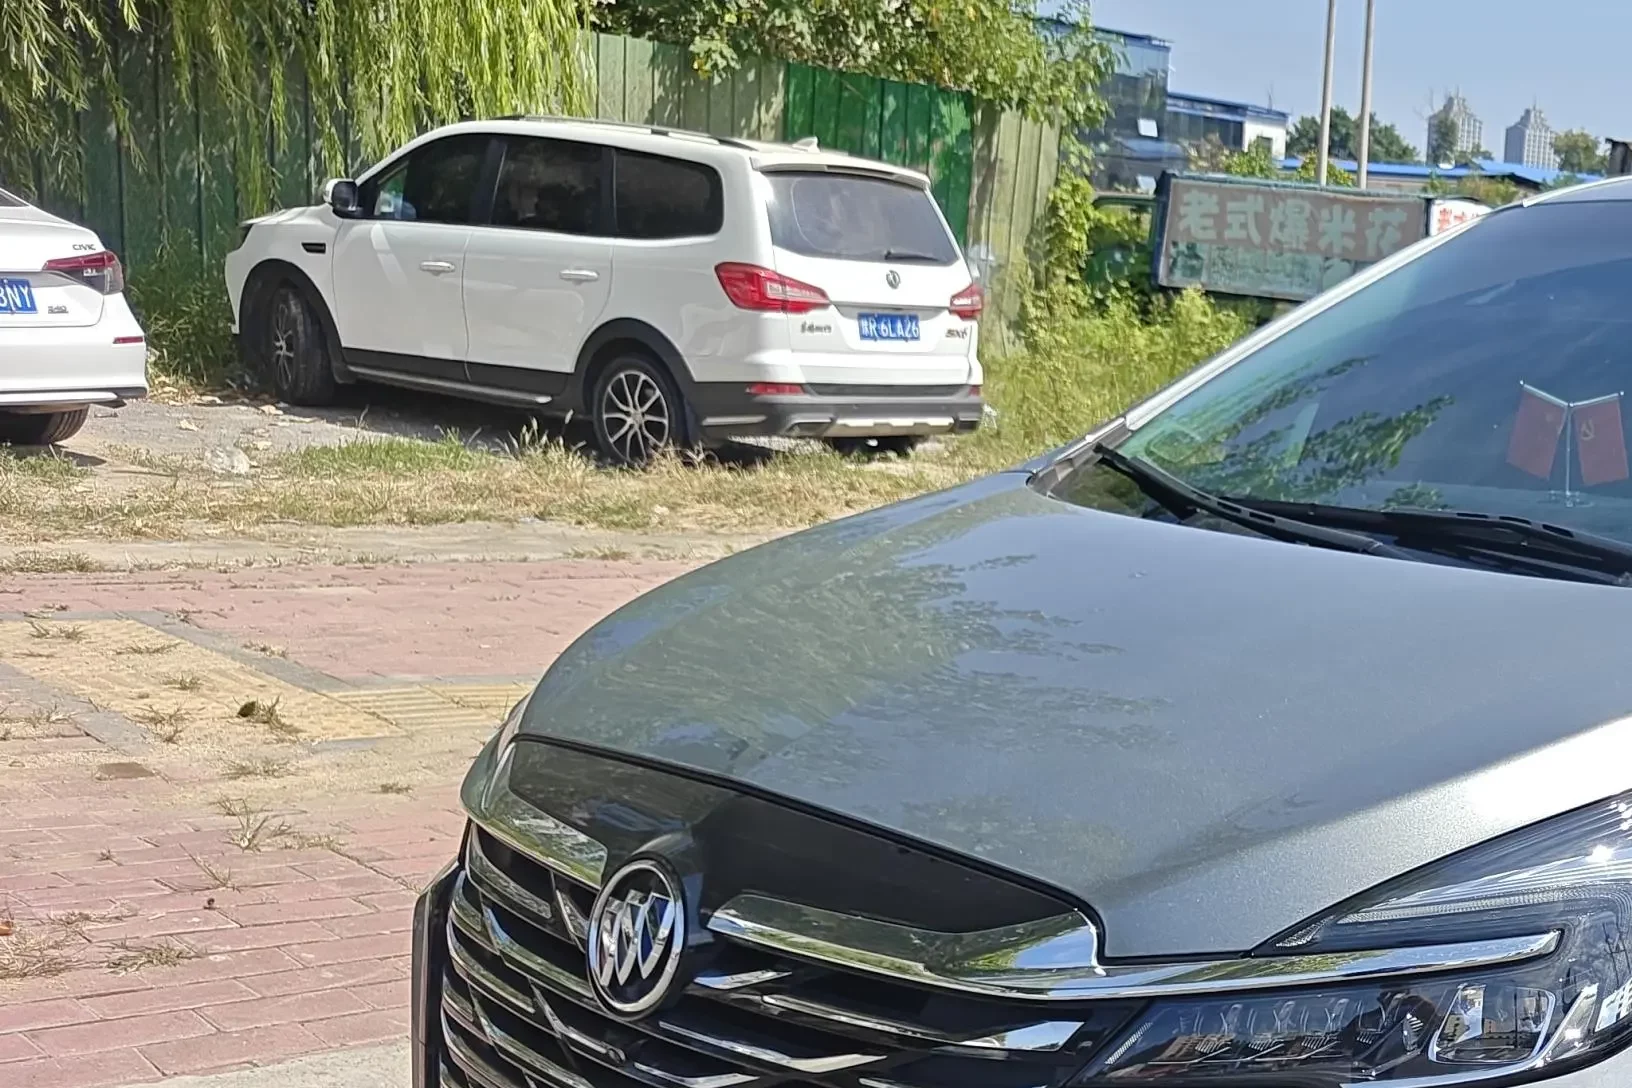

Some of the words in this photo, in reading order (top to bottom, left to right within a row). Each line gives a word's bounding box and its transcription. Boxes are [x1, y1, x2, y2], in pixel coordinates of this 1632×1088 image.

[1179, 191, 1407, 257] 老式爆米花
